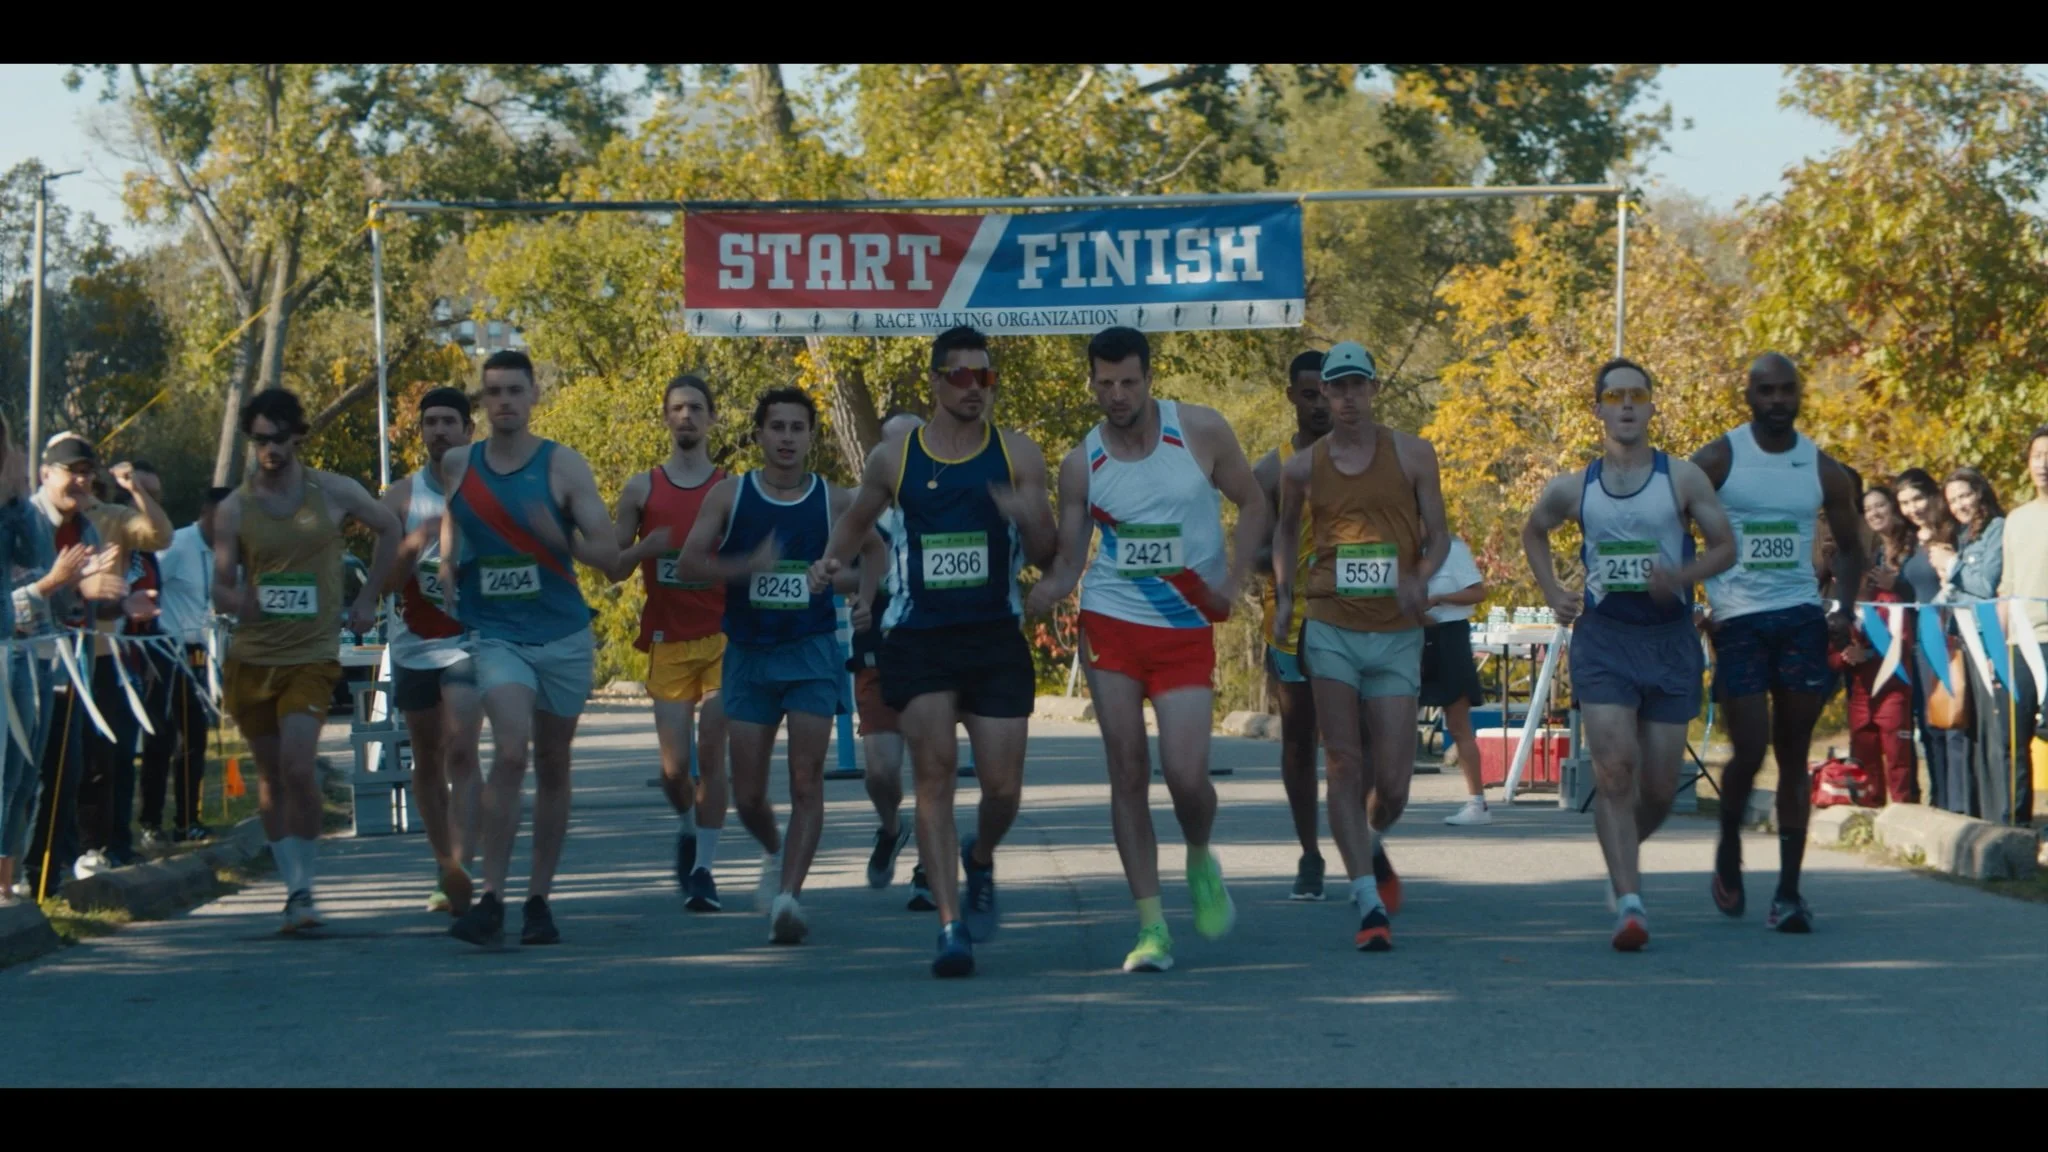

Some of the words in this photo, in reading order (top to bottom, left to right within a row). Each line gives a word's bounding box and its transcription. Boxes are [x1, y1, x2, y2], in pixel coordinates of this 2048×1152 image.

[718, 232, 941, 291] START
[1017, 225, 1264, 290] FINISH
[875, 312, 915, 328] RACE
[919, 311, 993, 329] WALKING
[997, 309, 1119, 328] ORGANIZATION
[1125, 541, 1173, 565] 2421
[1751, 537, 1795, 558] 2389
[931, 550, 981, 576] 2366
[1345, 561, 1392, 583] 5537
[1607, 558, 1653, 580] 2419
[486, 568, 532, 592] 2404
[757, 573, 801, 598] 8243
[265, 588, 310, 610] 2374
